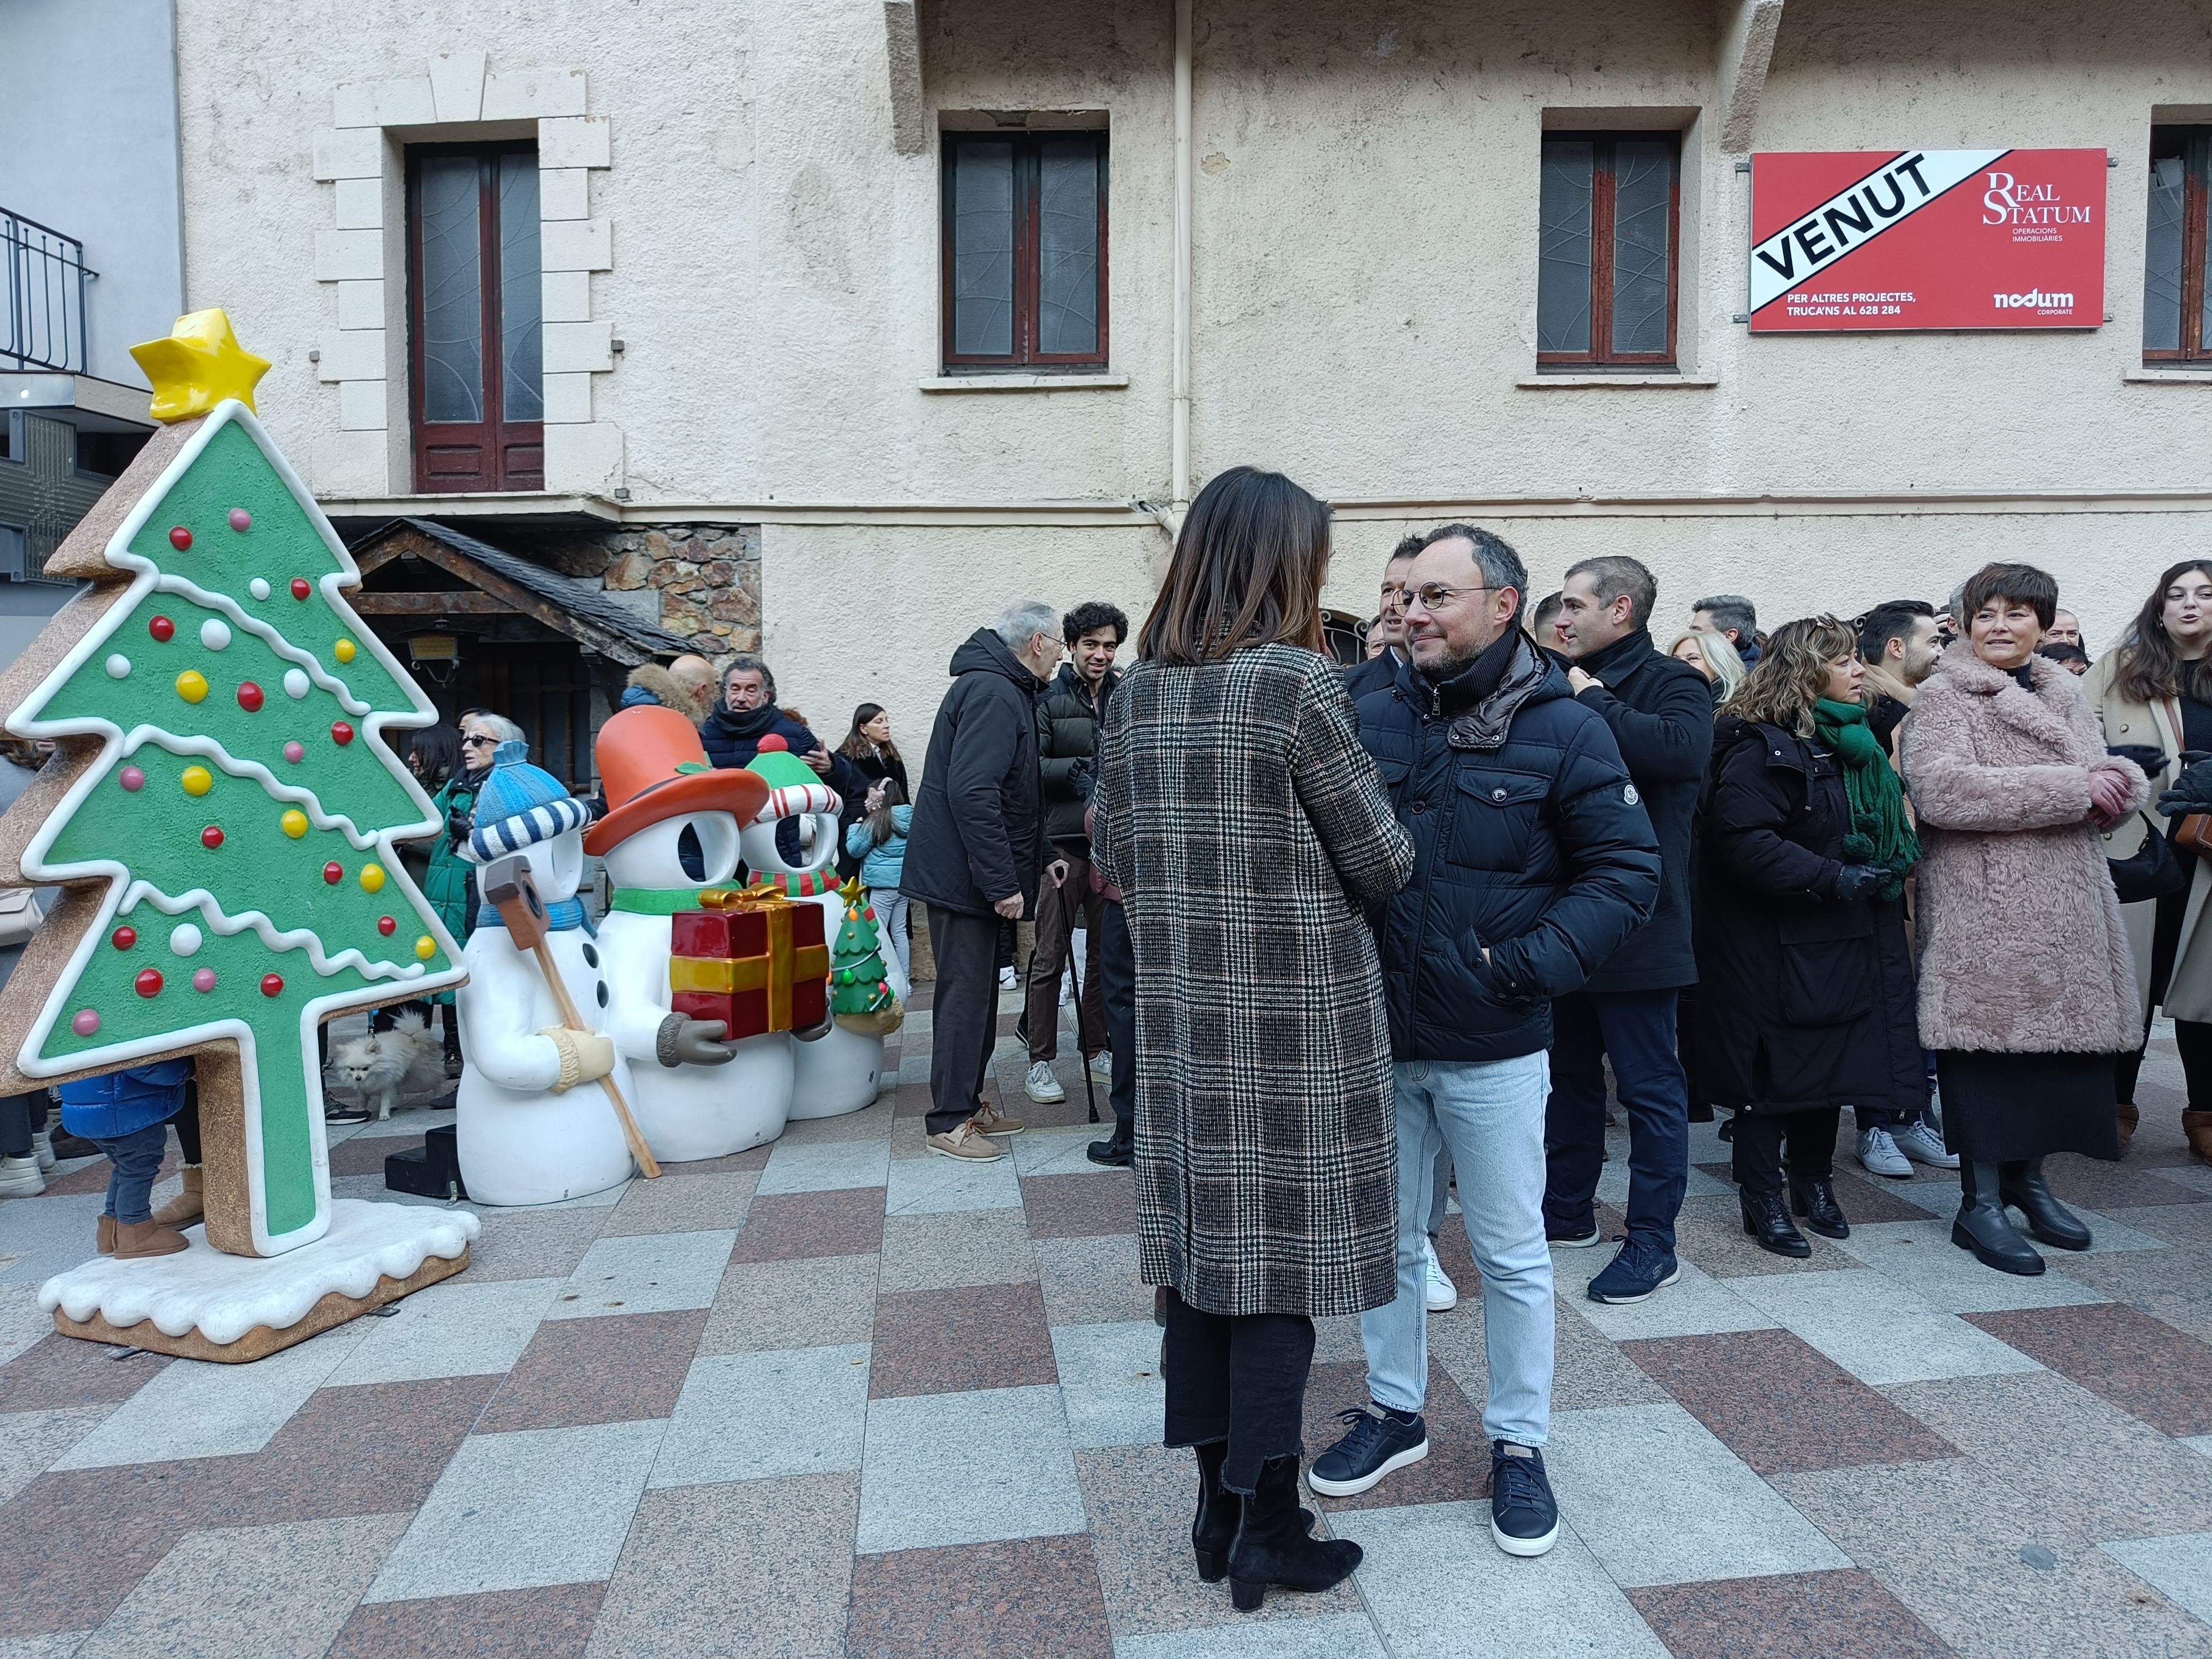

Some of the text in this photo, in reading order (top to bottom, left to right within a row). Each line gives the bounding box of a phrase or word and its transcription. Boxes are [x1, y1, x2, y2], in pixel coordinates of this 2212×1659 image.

[1756, 153, 1931, 281] VENUT
[2012, 234, 2063, 242] IMMOBILIÀRIES
[1787, 292, 1916, 303] PER ALTRES PROJECTES,
[1993, 288, 2074, 308] nodum
[1843, 306, 1857, 315] AL
[1859, 306, 1878, 315] 628
[1881, 305, 1900, 315] 284
